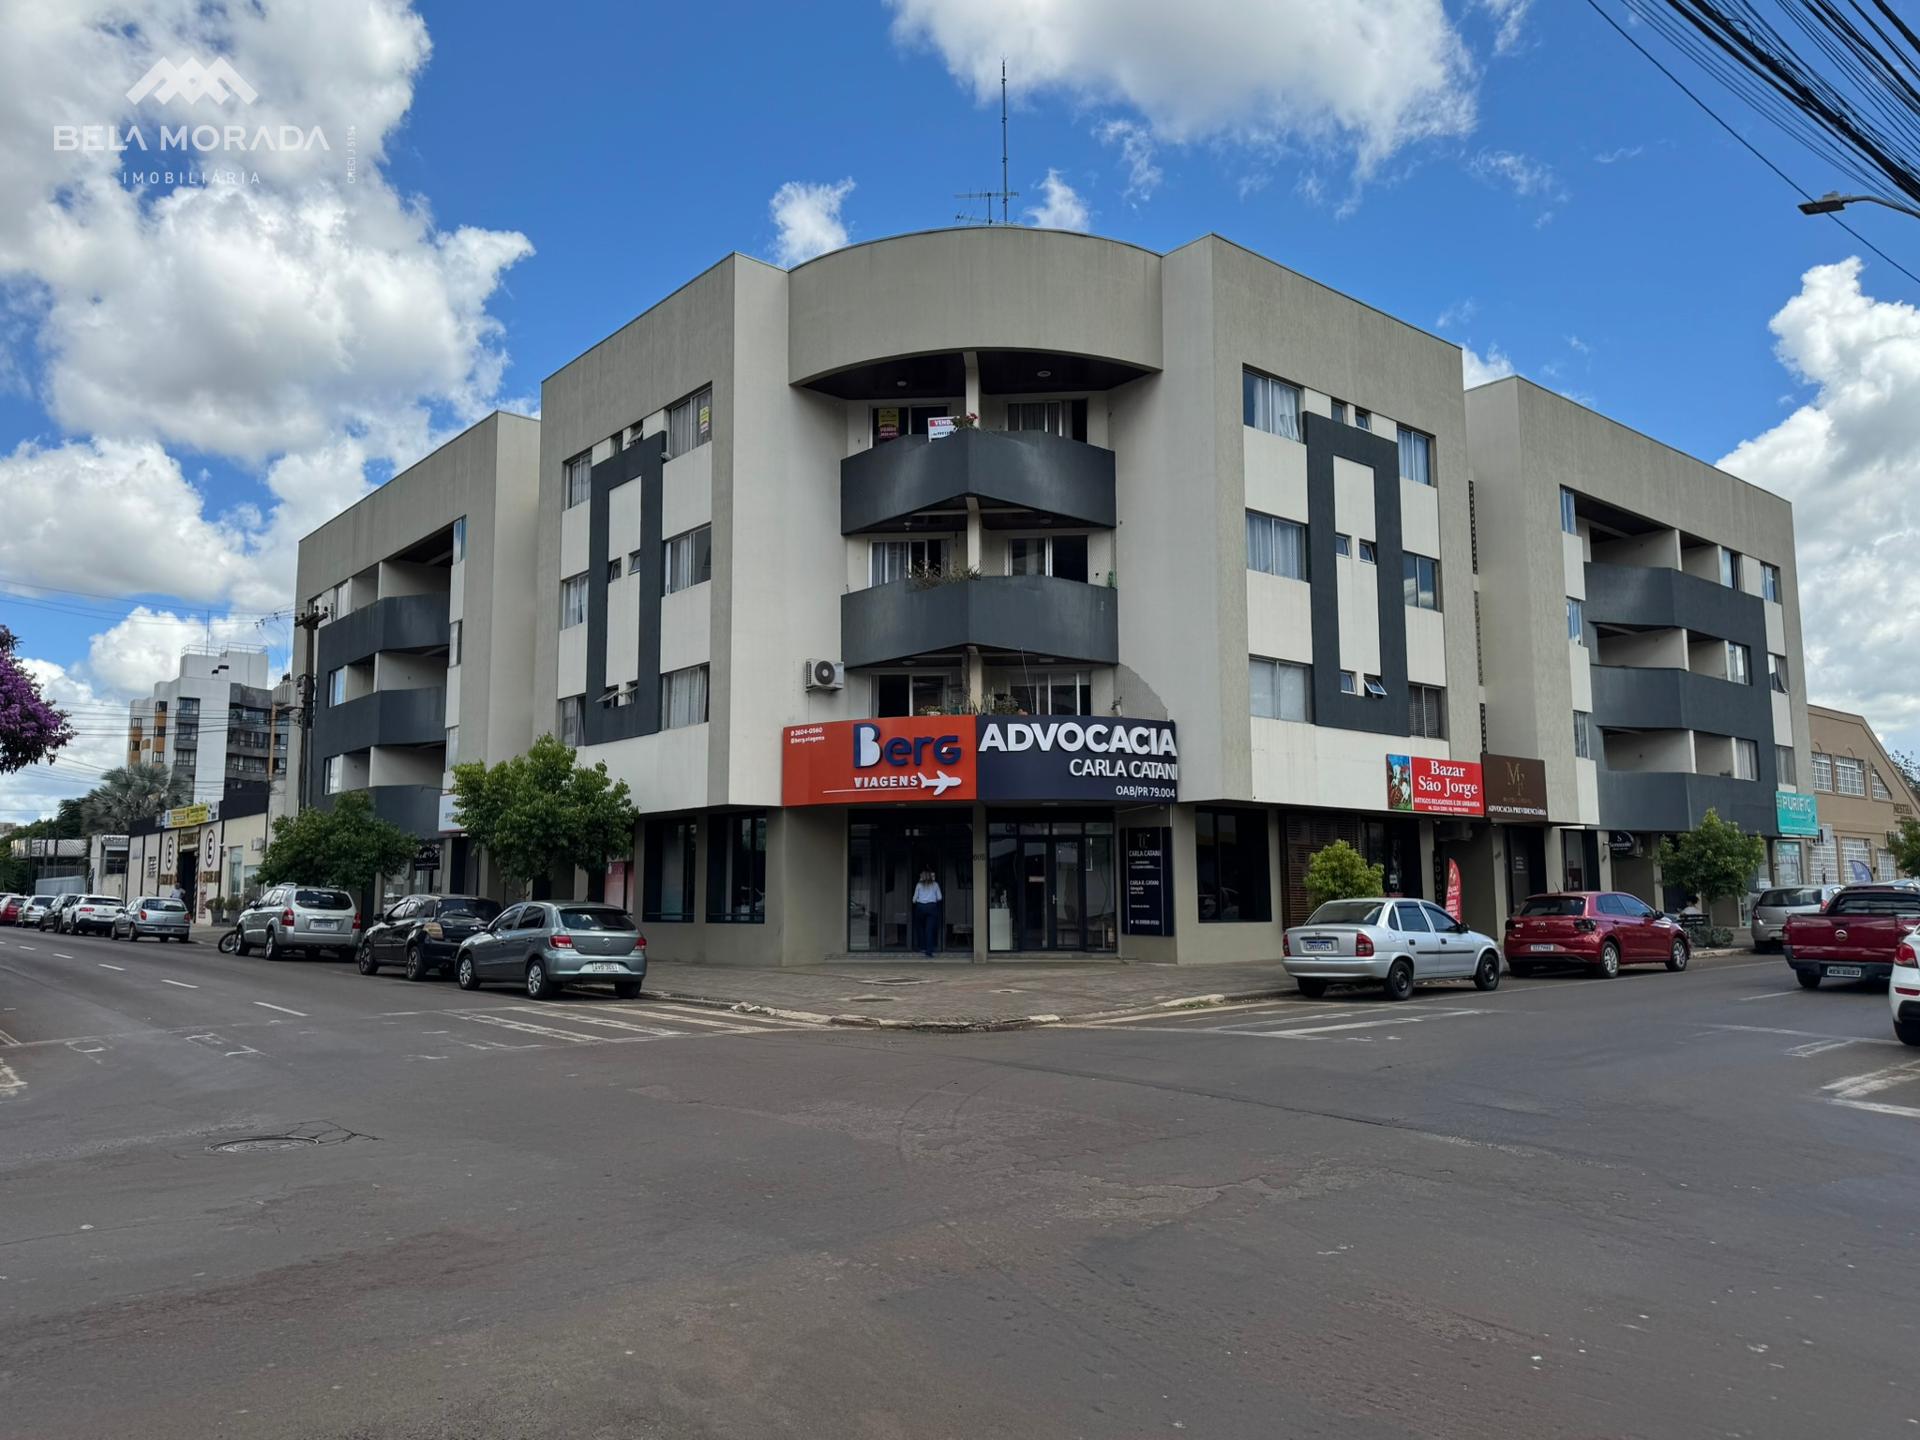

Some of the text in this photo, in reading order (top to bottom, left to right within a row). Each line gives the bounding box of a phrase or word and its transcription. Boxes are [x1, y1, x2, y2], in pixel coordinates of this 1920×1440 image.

[978, 722, 1178, 756] ADVOCACIA
[1069, 758, 1178, 780] CARLA CATANI
[1430, 760, 1466, 778] Bazar
[854, 775, 918, 788] VIAGENS
[1418, 775, 1479, 799] São Jorge
[1149, 787, 1176, 798] 79.004
